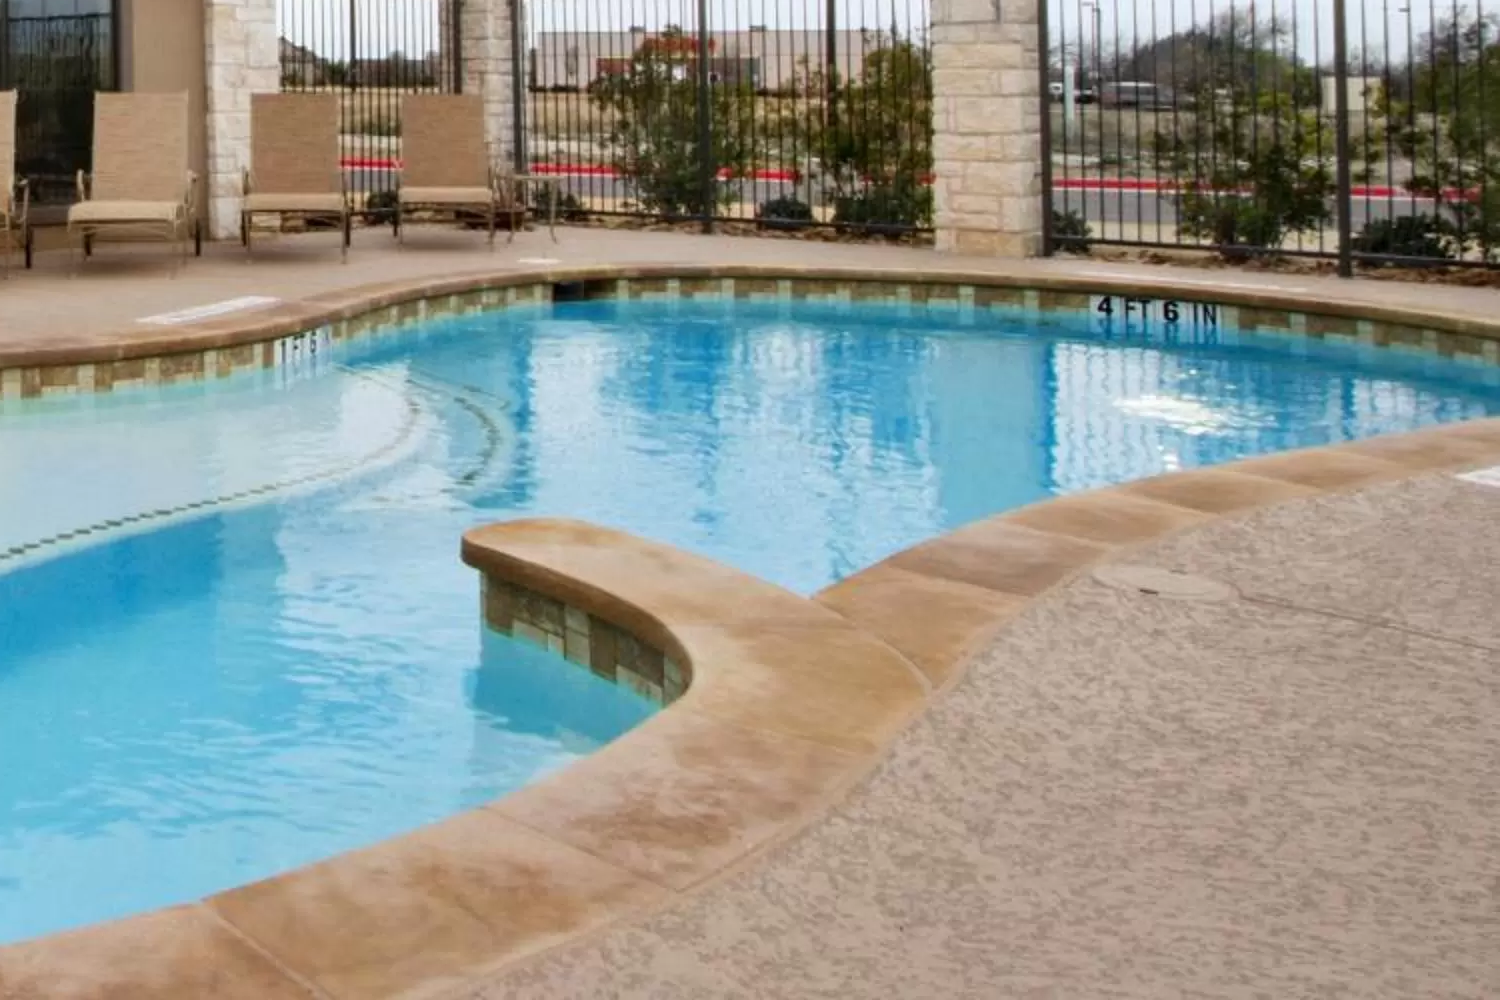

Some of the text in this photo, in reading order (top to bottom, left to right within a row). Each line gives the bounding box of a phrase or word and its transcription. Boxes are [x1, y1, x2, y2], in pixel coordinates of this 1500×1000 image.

[1097, 296, 1217, 326] 4 FT 6 IN
